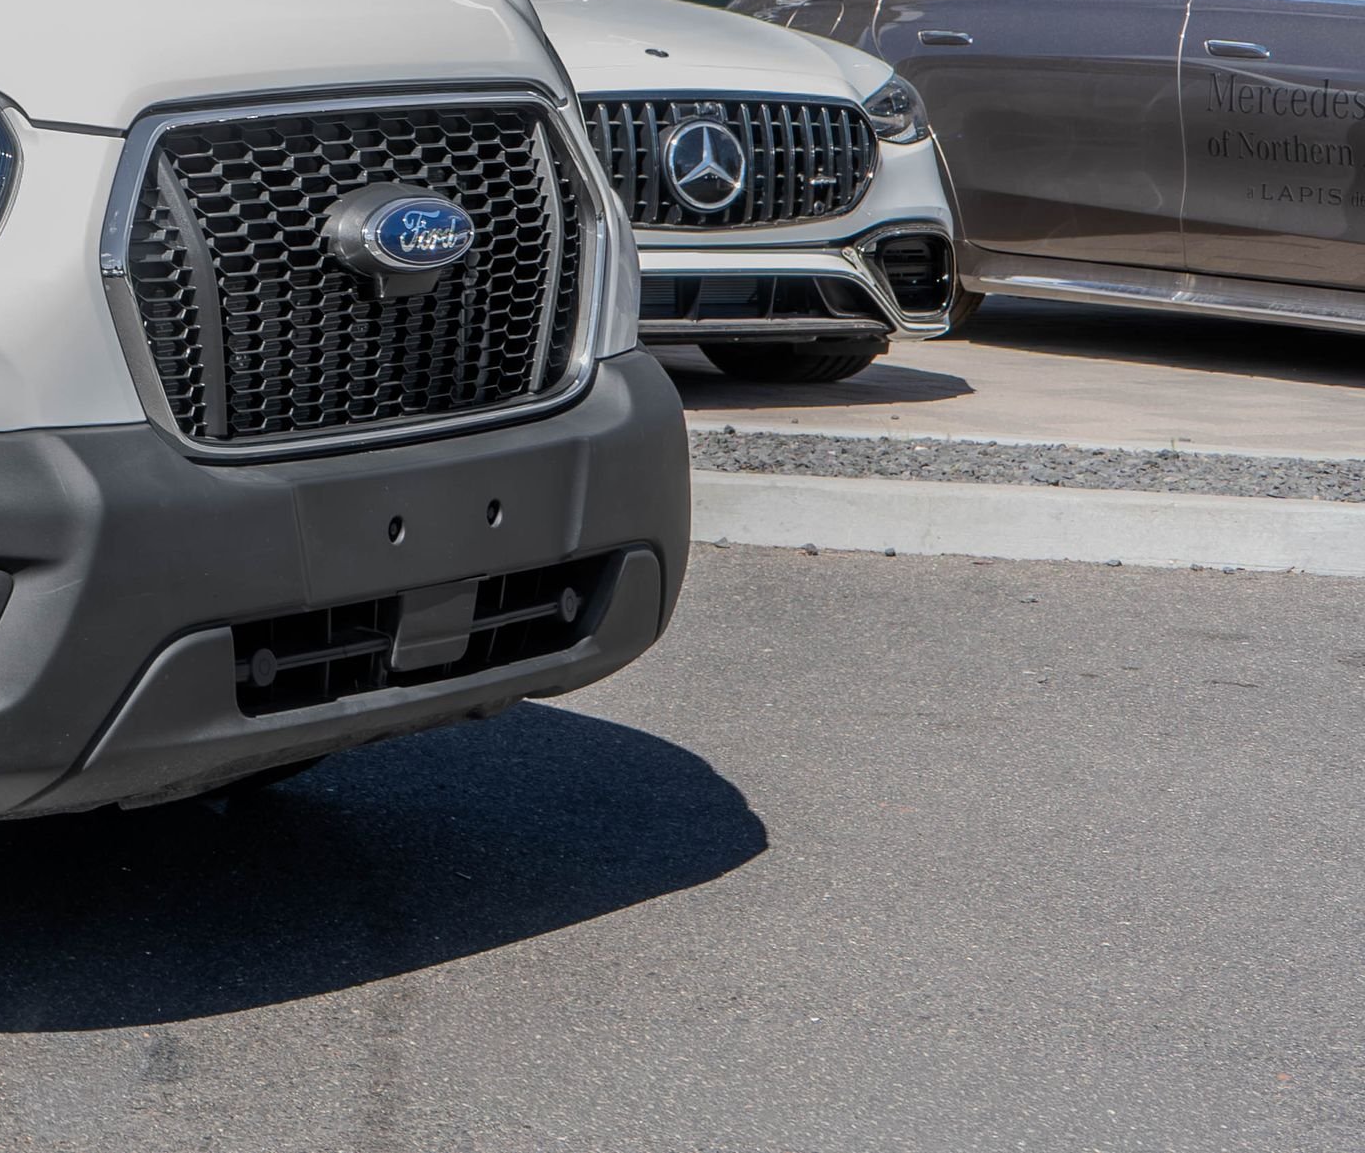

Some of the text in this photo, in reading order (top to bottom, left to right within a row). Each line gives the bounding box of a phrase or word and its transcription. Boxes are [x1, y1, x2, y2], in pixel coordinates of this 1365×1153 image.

[1207, 129, 1353, 167] of Northern
[1260, 183, 1342, 206] LAPIS
[399, 209, 457, 253] Ford
